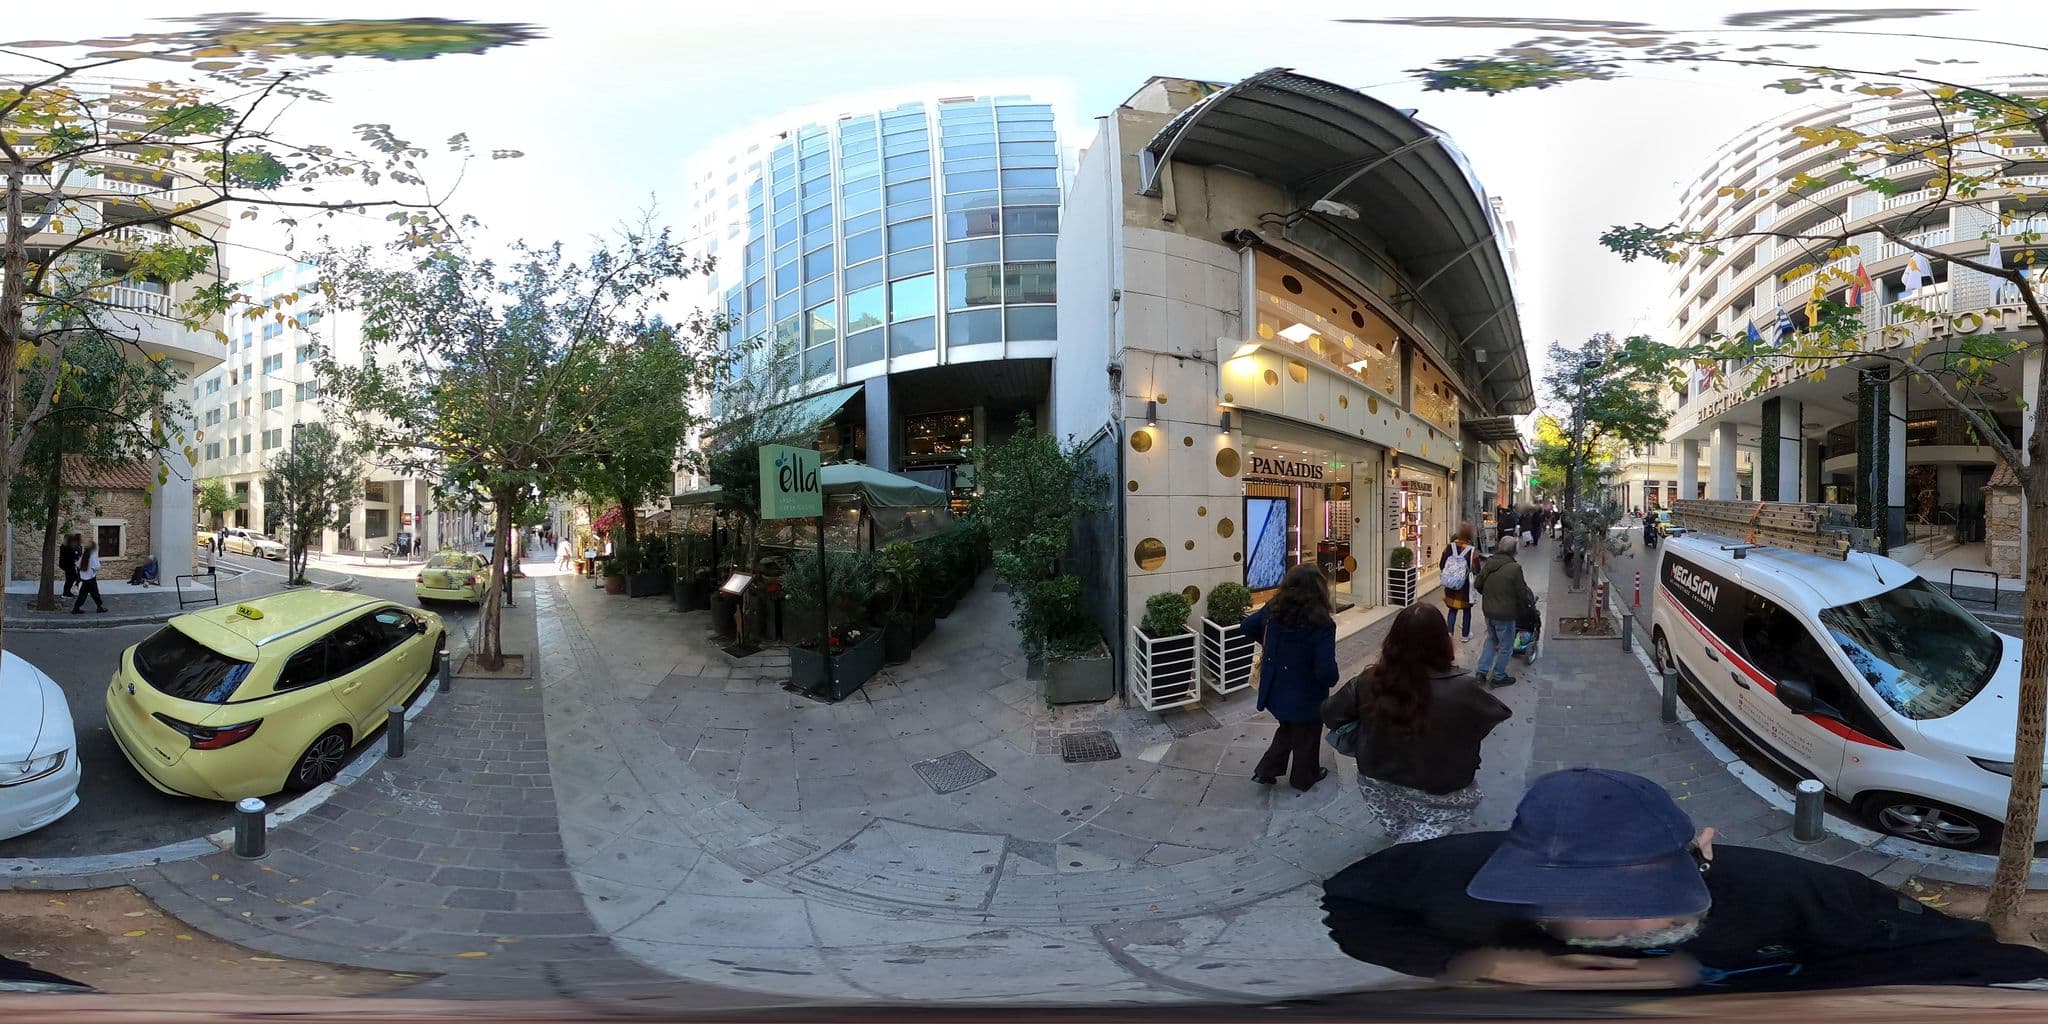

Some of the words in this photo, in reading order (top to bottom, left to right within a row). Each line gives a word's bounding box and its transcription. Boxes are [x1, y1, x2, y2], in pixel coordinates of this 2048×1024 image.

[1697, 389, 1747, 424] ELECTRA
[1926, 305, 2041, 340] HOTE
[779, 452, 819, 493] ella
[1251, 456, 1323, 480] PANAIDIS
[238, 606, 253, 616] TAXI
